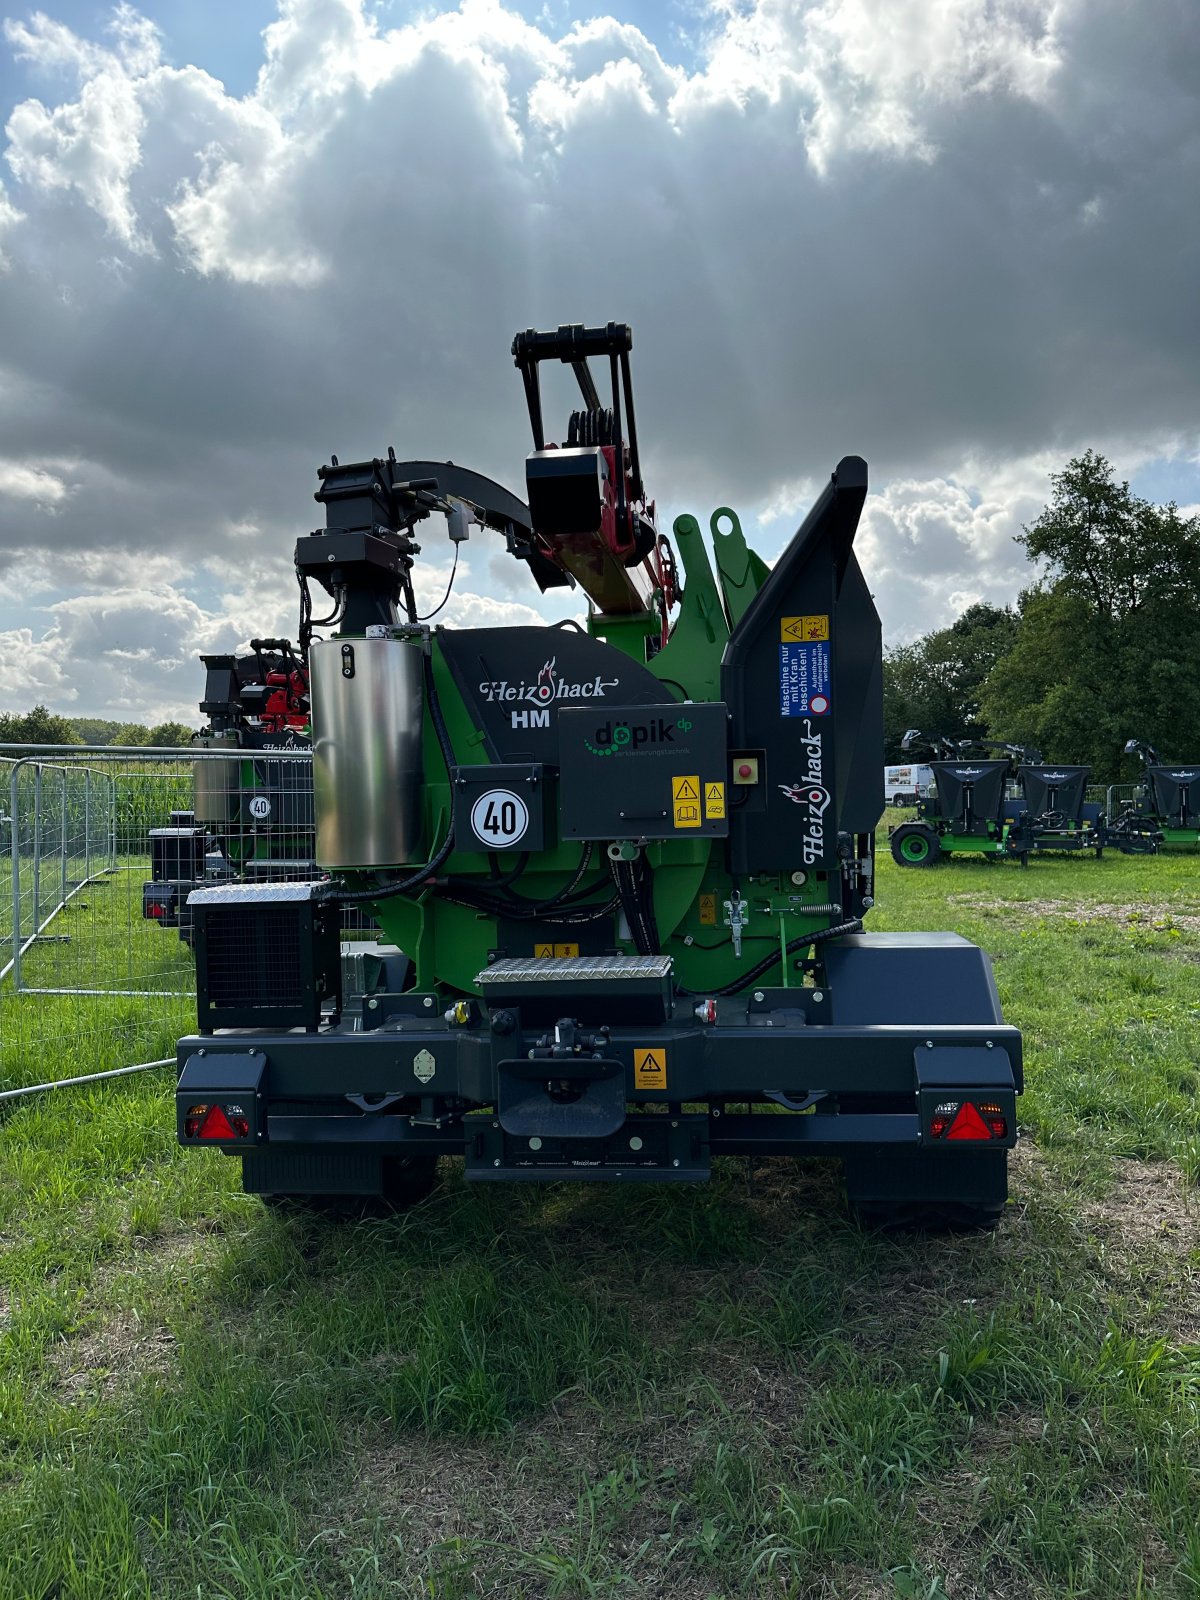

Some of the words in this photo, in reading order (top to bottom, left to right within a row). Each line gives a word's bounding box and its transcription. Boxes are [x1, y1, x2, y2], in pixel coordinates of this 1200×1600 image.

[790, 658, 798, 682] Kran
[799, 649, 808, 711] beschicken!
[781, 666, 790, 716] Maschine
[790, 687, 798, 703] mit
[511, 709, 550, 729] HM
[595, 718, 675, 749] döpik
[255, 801, 267, 813] 40
[483, 801, 516, 836] 40
